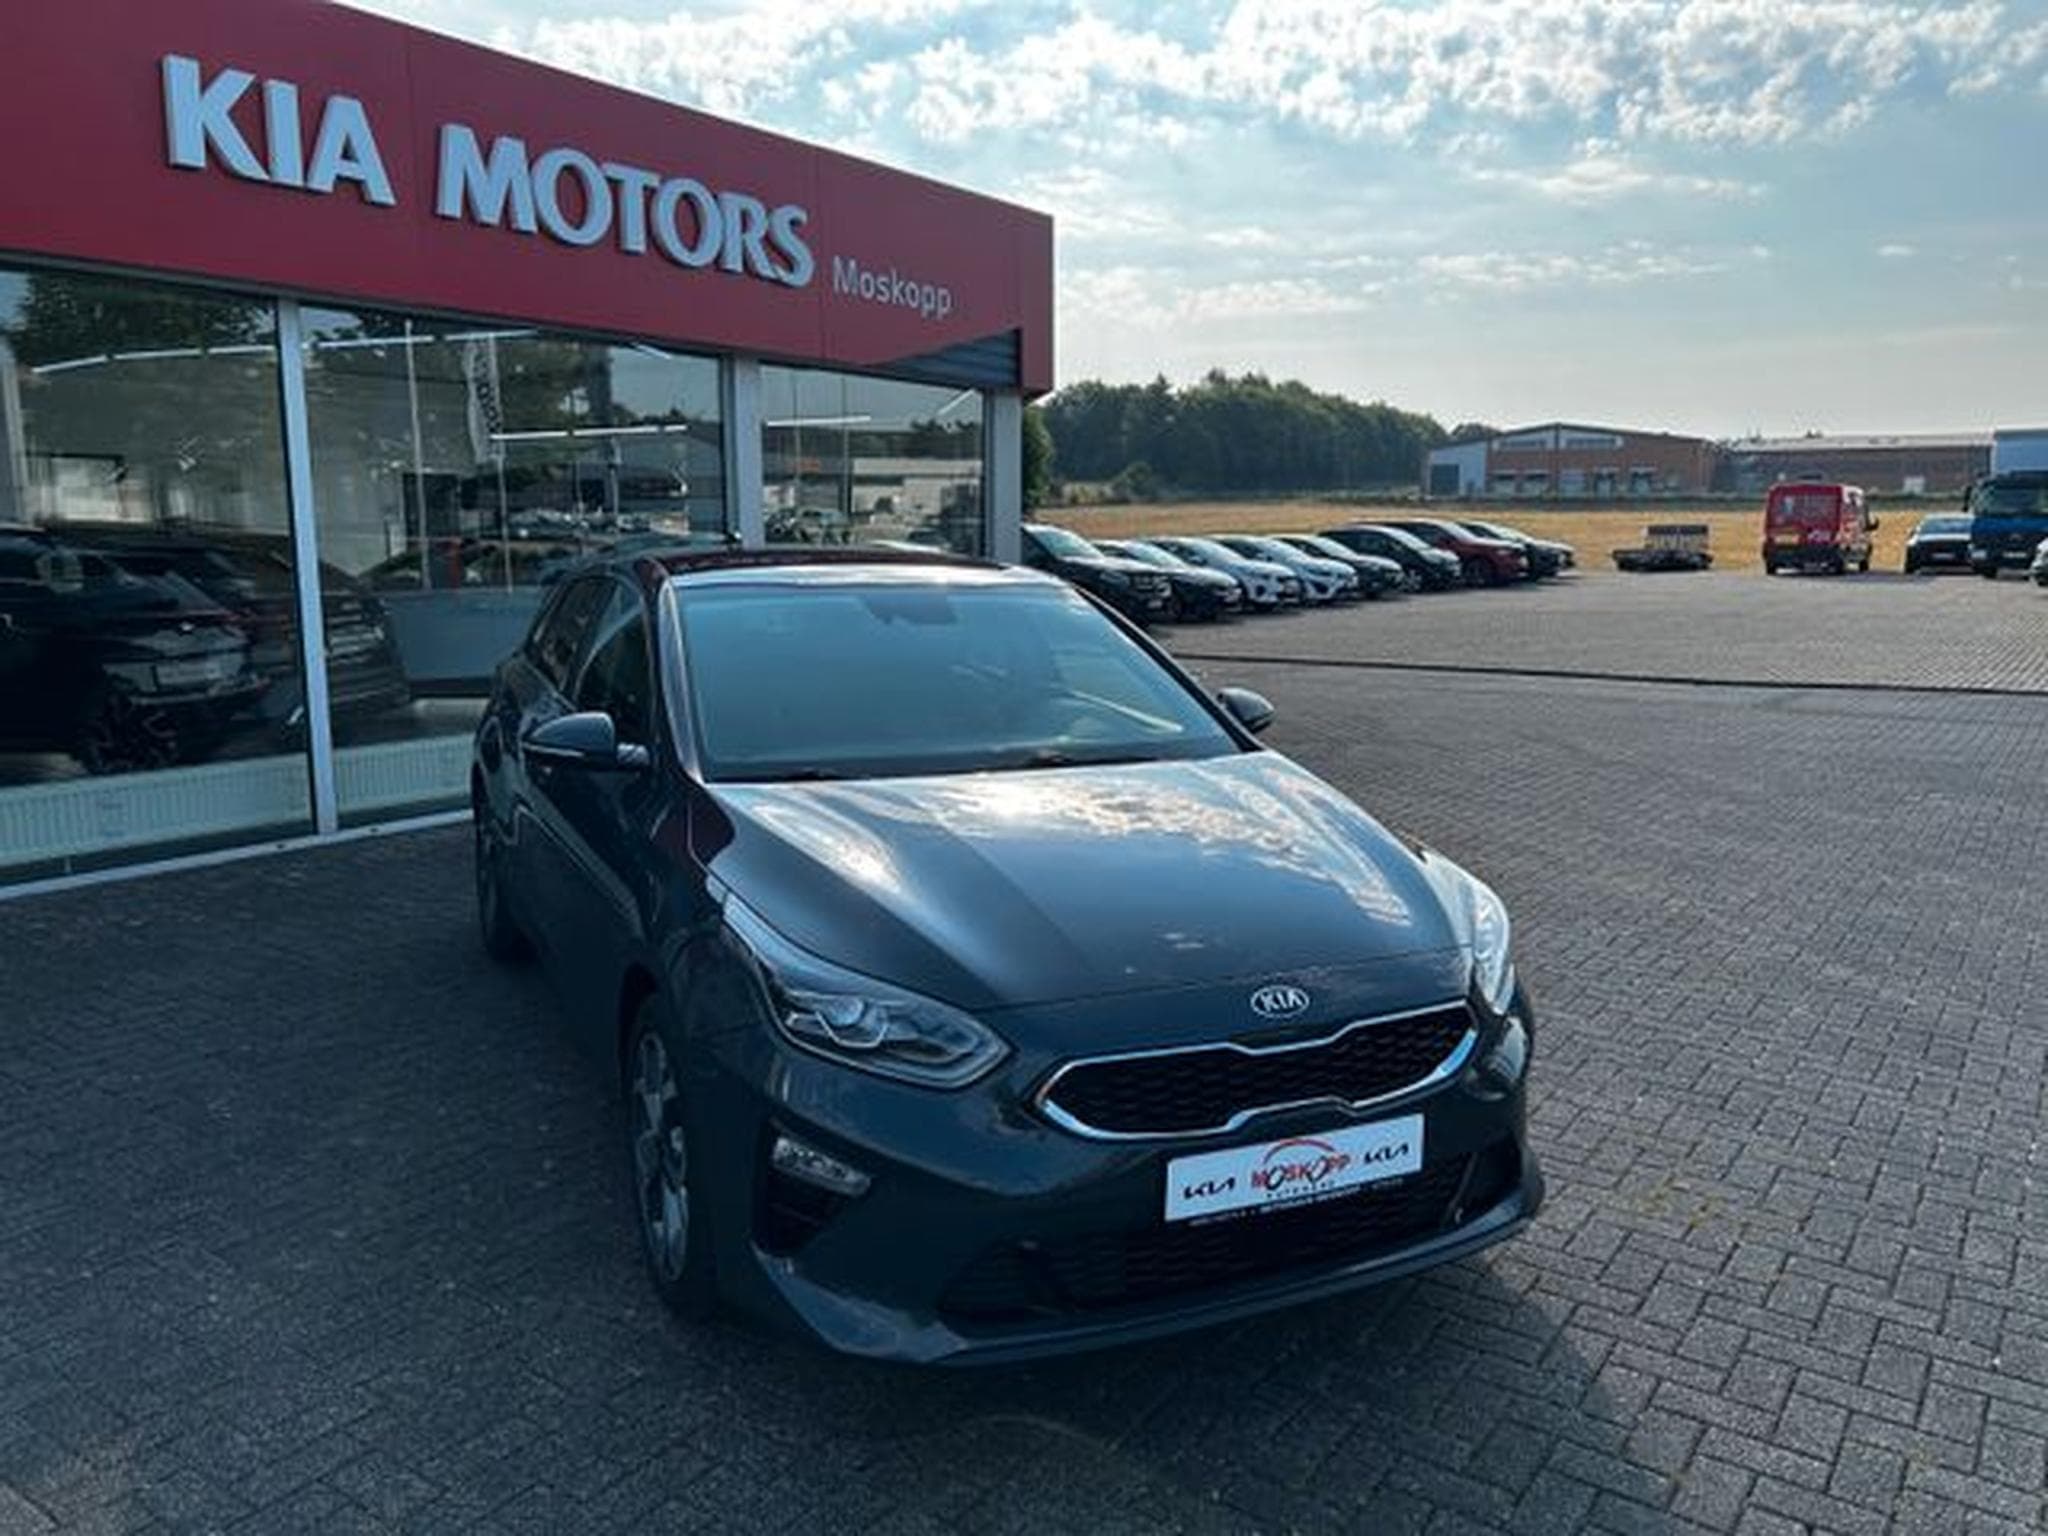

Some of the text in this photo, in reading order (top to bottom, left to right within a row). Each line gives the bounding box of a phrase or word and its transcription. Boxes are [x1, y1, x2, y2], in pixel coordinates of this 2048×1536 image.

[162, 54, 816, 289] KIA MOTORS
[832, 255, 953, 320] Moskopp
[1260, 989, 1303, 1012] KIA
[1184, 1176, 1236, 1199] KIA
[1364, 1142, 1409, 1165] KIA
